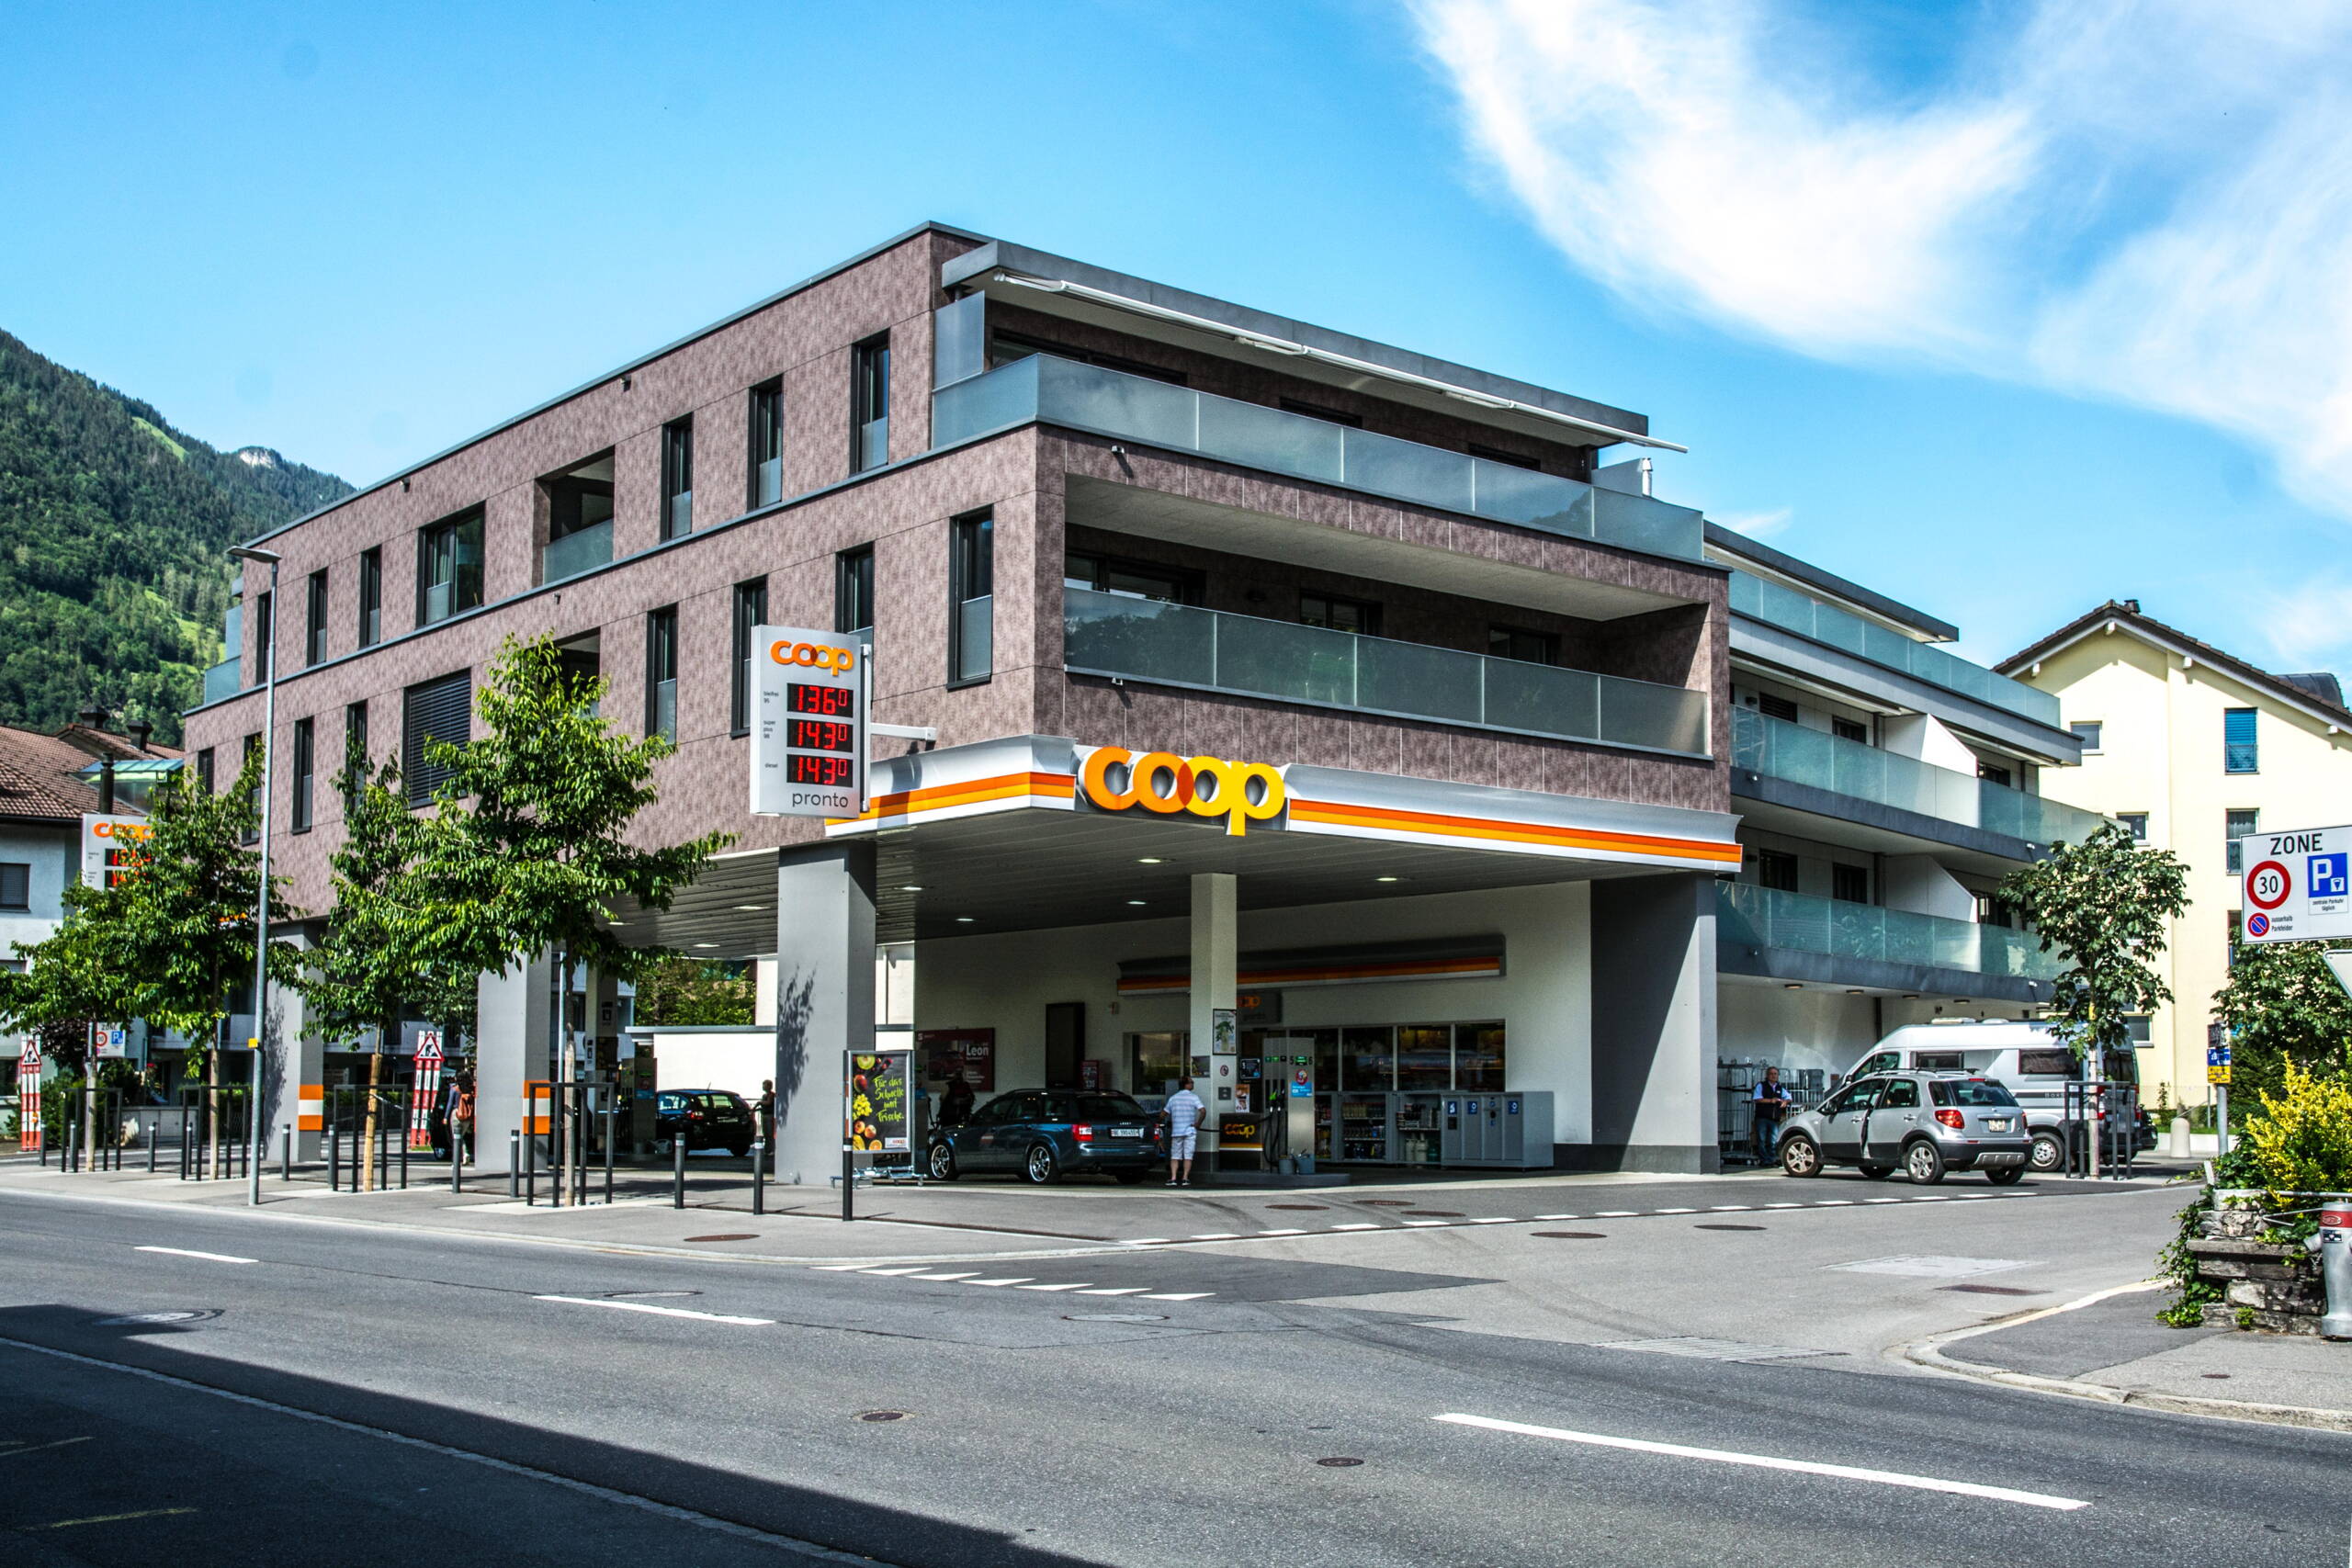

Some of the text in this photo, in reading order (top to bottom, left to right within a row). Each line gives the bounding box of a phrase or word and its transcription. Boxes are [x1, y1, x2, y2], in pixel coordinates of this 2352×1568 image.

[770, 640, 854, 676] coop
[792, 792, 849, 808] pronto
[1082, 745, 1285, 837] coop
[2270, 832, 2324, 856] ZONE
[2312, 858, 2333, 891] P
[2258, 875, 2278, 894] 30
[2271, 923, 2293, 931] Parkfelder
[966, 1043, 989, 1056] Leon
[873, 1075, 902, 1089] Für das
[1223, 1122, 1256, 1139] coop
